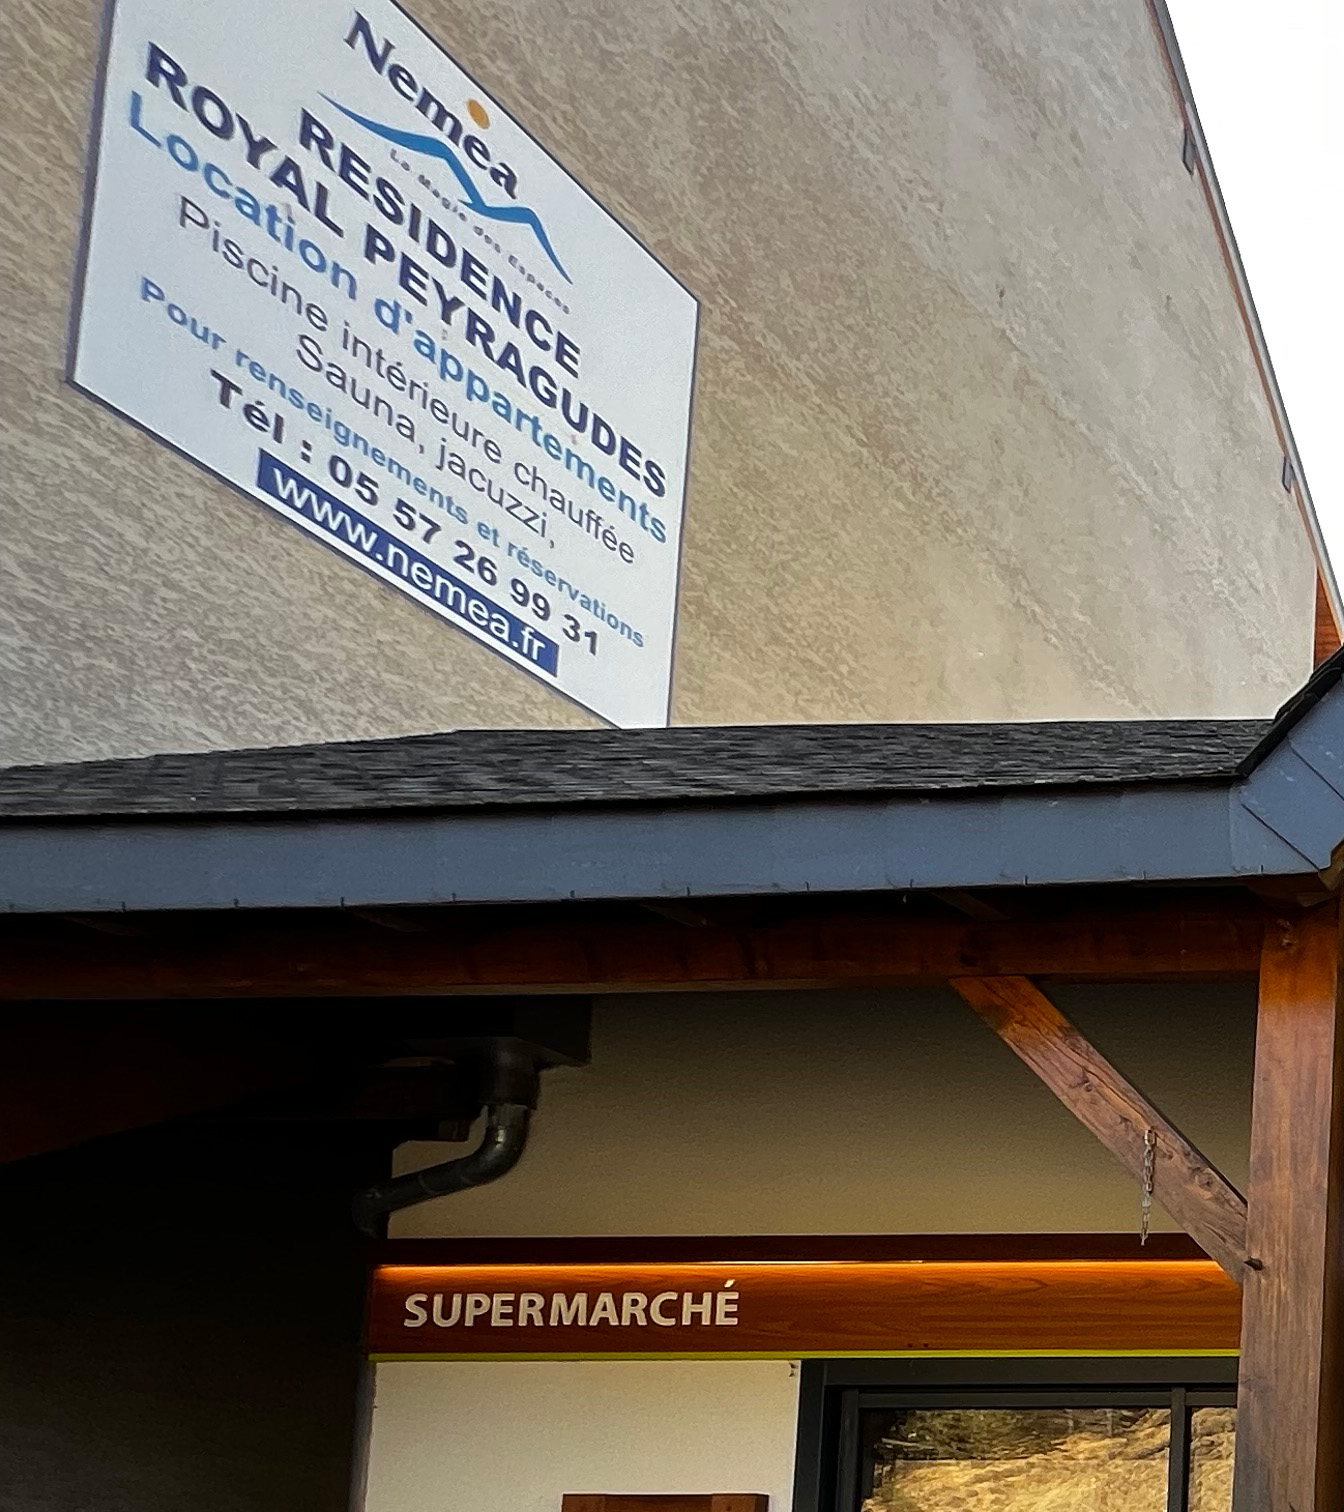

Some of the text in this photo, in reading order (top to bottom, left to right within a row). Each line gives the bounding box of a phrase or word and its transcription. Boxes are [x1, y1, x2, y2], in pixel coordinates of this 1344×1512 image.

[130, 90, 667, 544] Location d'appartements
[145, 41, 666, 498] ROYAL PEYRAGUDES
[179, 194, 634, 565] Piscine intérieure chauffée
[300, 107, 581, 379] RESIDENCE
[418, 174, 467, 222] Magie
[508, 254, 571, 315] Espaces
[141, 276, 644, 648] Pour renseignements et réservations
[210, 368, 285, 444] Tél
[328, 454, 380, 507] 05
[393, 496, 442, 545] 57
[453, 539, 498, 586] 26
[510, 577, 551, 622] 99
[562, 613, 598, 656] 31
[274, 466, 546, 663] www.nemea.fr
[297, 334, 555, 549] Sauna, jacuzzi,
[403, 1279, 740, 1328] SUPERMARCHÉ
